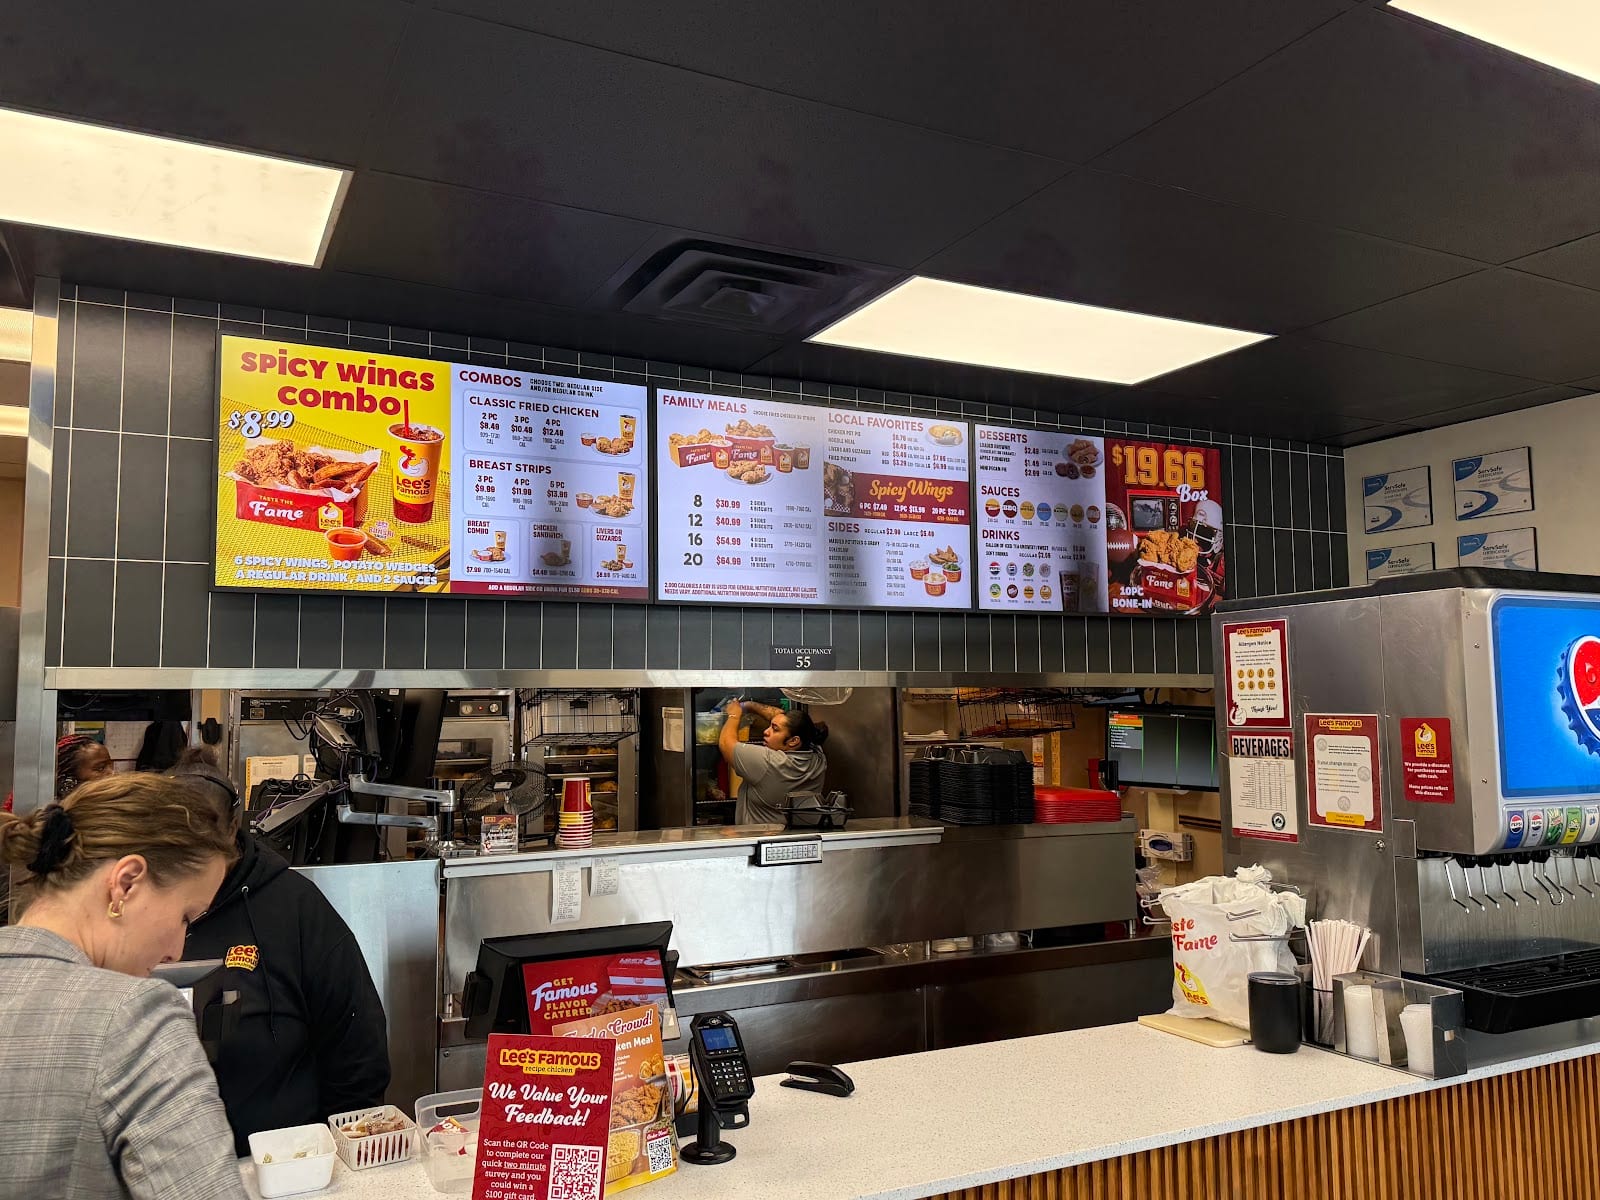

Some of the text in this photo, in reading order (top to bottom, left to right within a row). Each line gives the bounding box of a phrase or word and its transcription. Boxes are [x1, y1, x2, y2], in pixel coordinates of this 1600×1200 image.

[459, 370, 522, 388] COMBOS
[277, 385, 401, 416] combo
[469, 396, 599, 418] CLASSIC FRIED CHICKEN
[662, 394, 748, 414] FAMILY MEALS
[228, 409, 294, 438] $8.99
[482, 412, 498, 421] 2 PC
[514, 415, 530, 424] 3 PC
[545, 418, 561, 427] 4 PC
[828, 412, 924, 432] LOCAL FAVORITES
[979, 429, 1028, 444] DESSERTS
[732, 448, 758, 459] Fame
[469, 458, 552, 474] BREAST STRIPS
[1112, 444, 1206, 490] $19.66
[477, 475, 482, 483] 3
[520, 478, 530, 486] PC
[556, 481, 565, 489] PC
[869, 479, 954, 503] Spicy Wings
[981, 485, 1020, 498] SAUCES
[1176, 483, 1209, 503] Box
[693, 494, 703, 508] 8
[249, 501, 304, 520] Fame
[467, 520, 490, 528] BREAST
[687, 513, 703, 527] 12
[828, 521, 860, 533] SIDES
[687, 532, 703, 546] 16
[982, 529, 1020, 541] DRINKS
[234, 556, 439, 575] 6 SPICY WINGS, POTATO WEDGES,
[683, 552, 703, 566] 20
[247, 570, 307, 581] REGULAR
[357, 574, 382, 584] AND
[392, 575, 438, 586] SAUCES
[1146, 574, 1174, 589] Fame
[1119, 585, 1144, 597] 10PC
[1112, 597, 1153, 609] BONE-IN
[796, 656, 811, 668] 55
[1319, 719, 1335, 727] Lee's
[1233, 737, 1289, 757] BEVERAGES
[1171, 917, 1195, 932] ste
[1173, 934, 1218, 951] Fame
[552, 977, 573, 987] GET
[531, 981, 598, 1011] Famous
[546, 998, 588, 1012] FLAVOR
[543, 1006, 593, 1020] CATERED
[607, 1008, 653, 1035] Crowd!
[616, 1034, 654, 1050] ken Meal
[502, 1051, 599, 1067] Lee's Famous
[547, 1066, 573, 1074] chicken
[488, 1082, 608, 1110] We Value Your
[504, 1104, 591, 1127] Feedback!
[483, 1138, 549, 1150] Scan the QR Code
[495, 1150, 529, 1160] complete
[530, 1152, 544, 1160] our
[481, 1160, 547, 1171] quick two minute
[484, 1171, 541, 1181] survey and you
[490, 1181, 511, 1189] could
[512, 1182, 528, 1190] win
[485, 1190, 536, 1200] $100 gift card.
